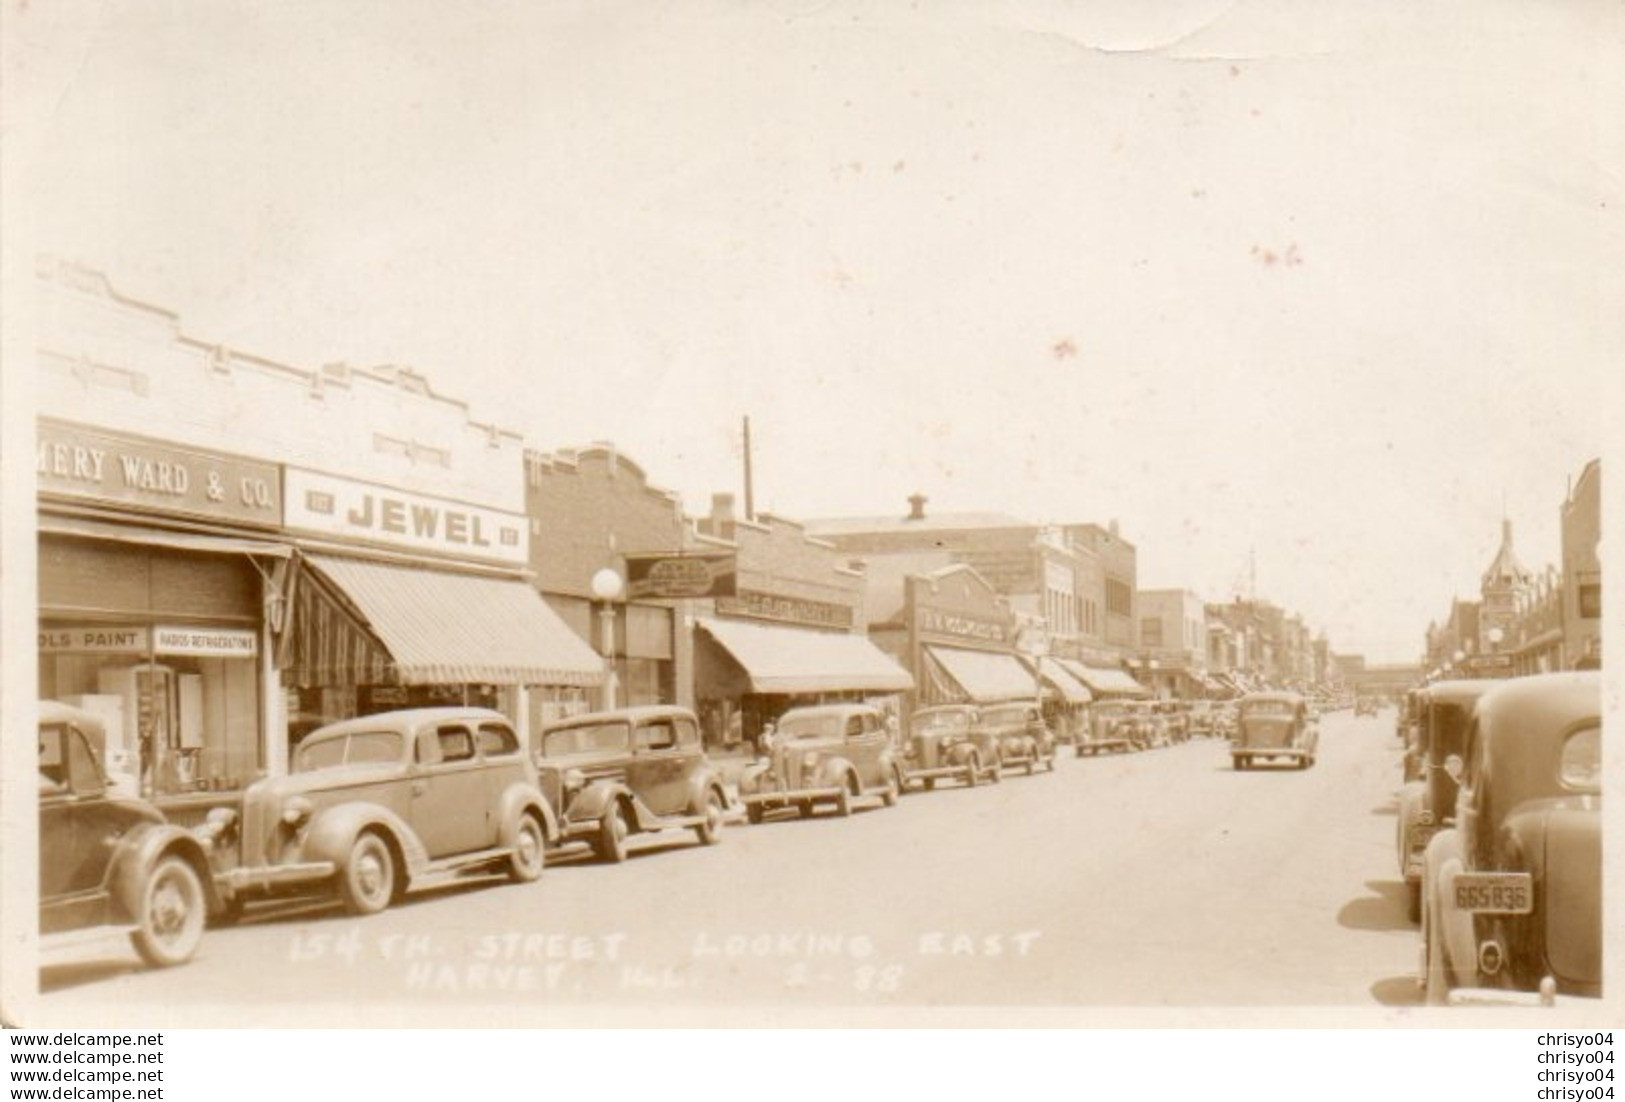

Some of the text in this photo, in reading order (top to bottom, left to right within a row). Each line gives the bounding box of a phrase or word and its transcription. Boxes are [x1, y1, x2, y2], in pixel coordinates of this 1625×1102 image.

[119, 455, 189, 494] WARD
[206, 470, 225, 501] &
[240, 476, 274, 508] CO.
[348, 494, 490, 547] JEWEL
[84, 632, 139, 648] PAINT
